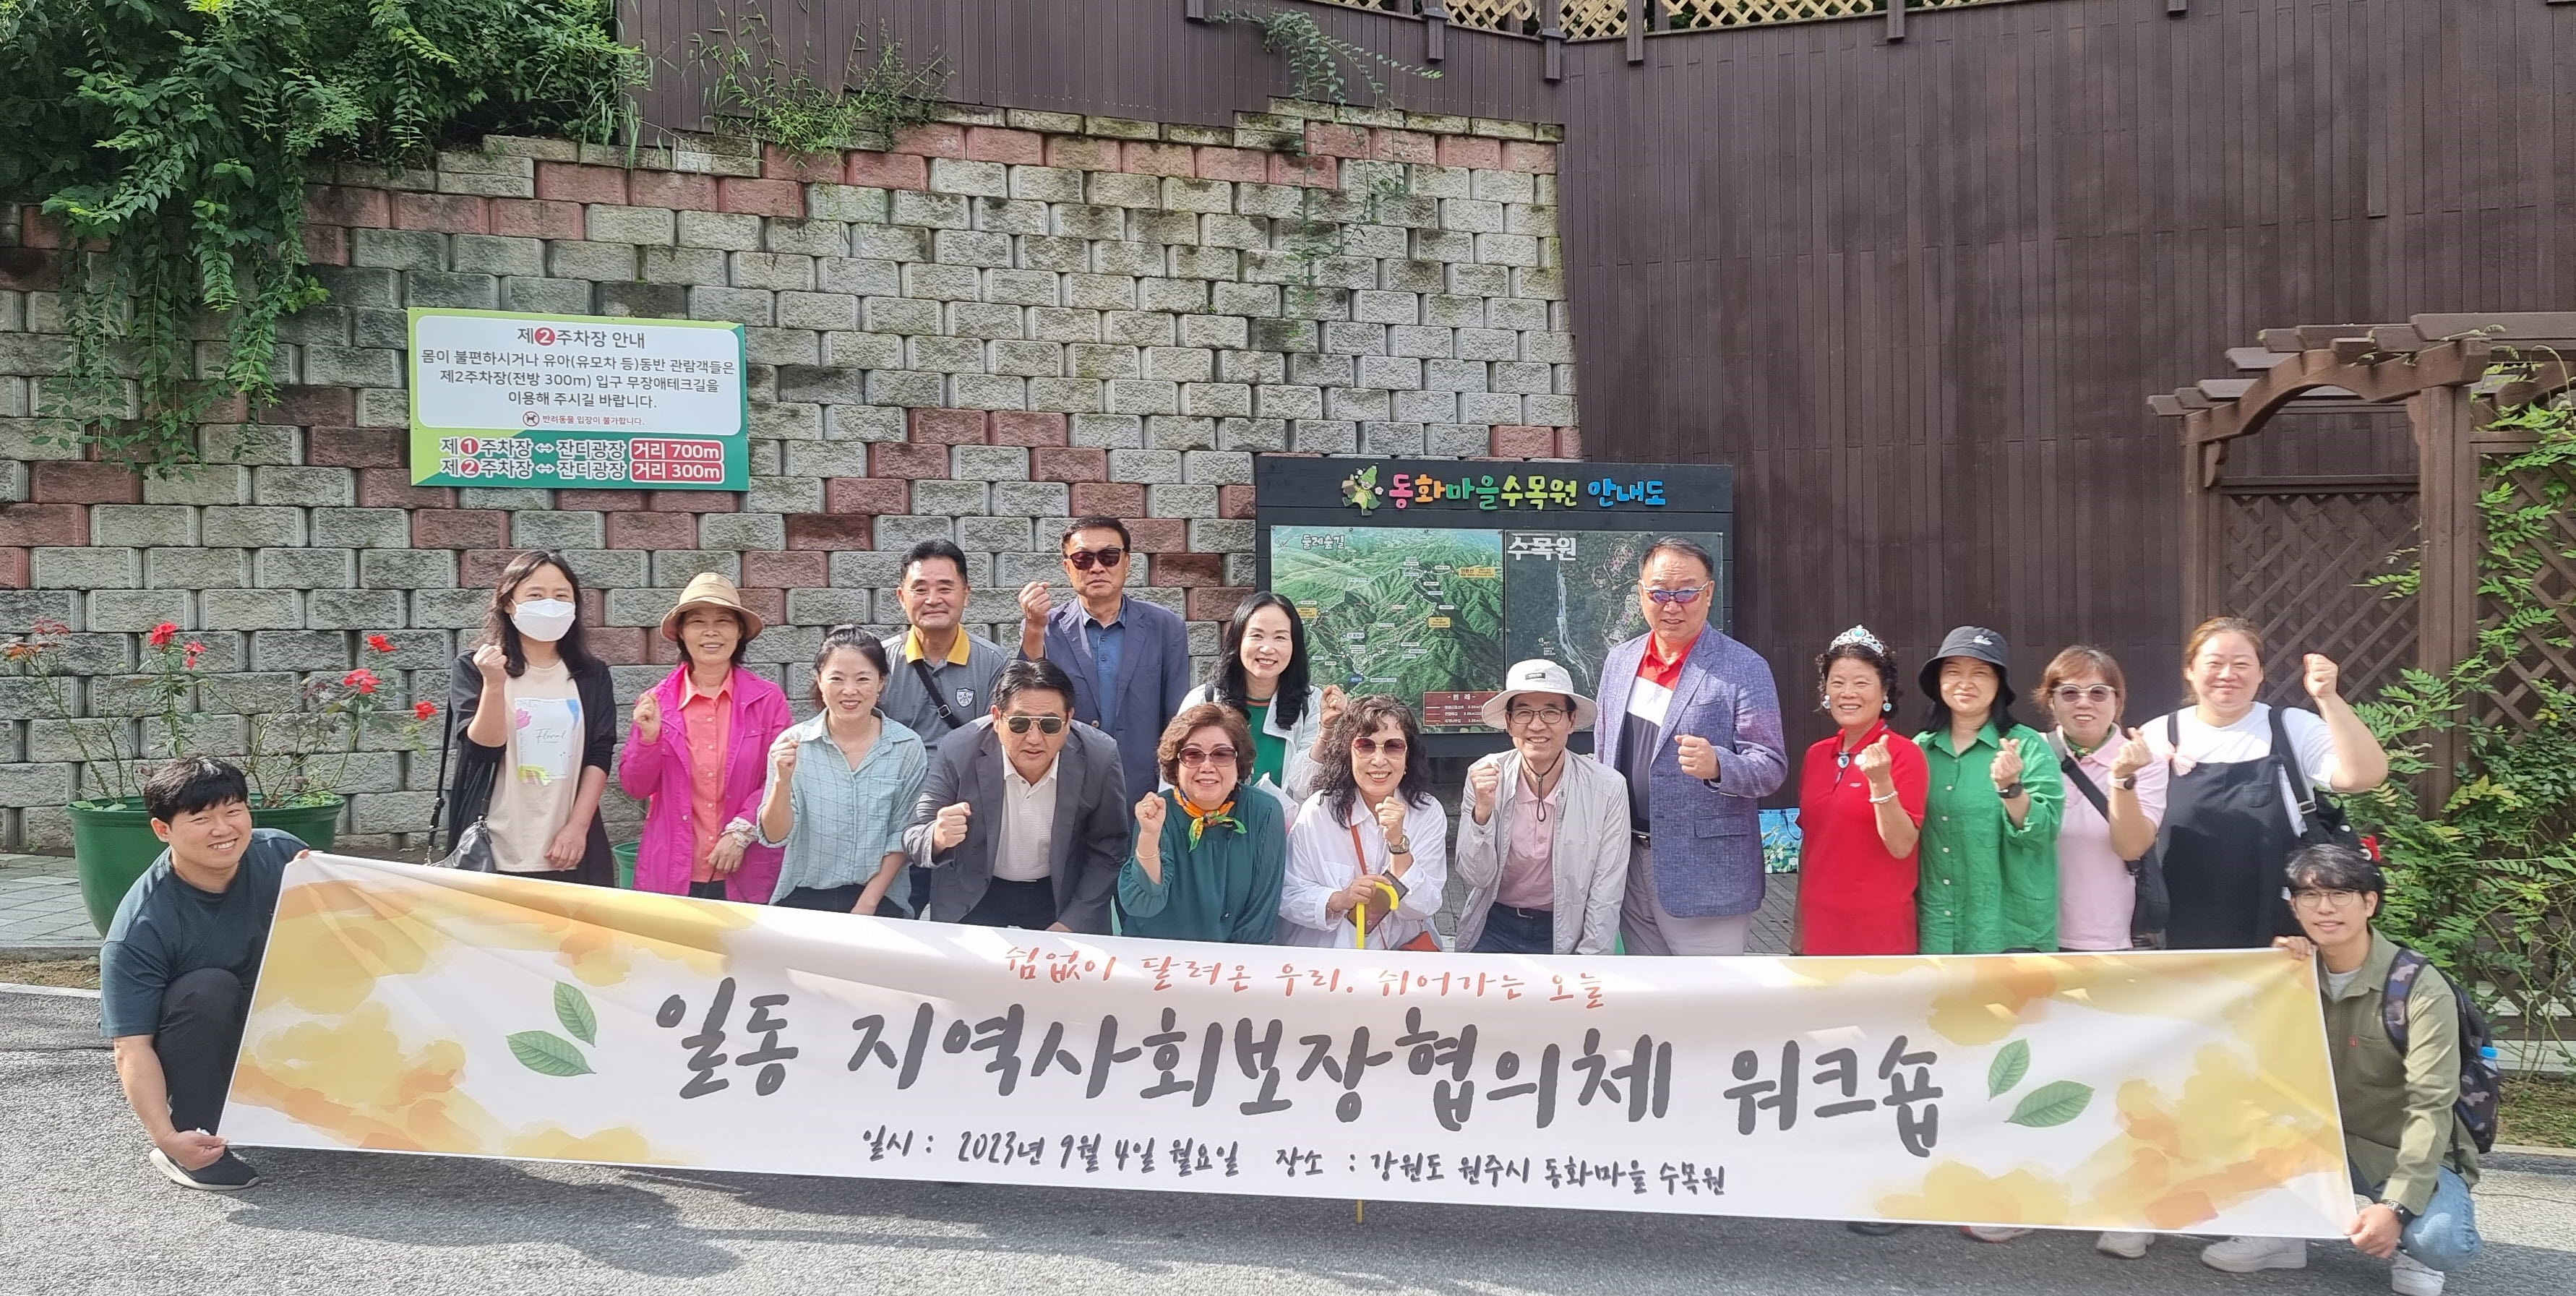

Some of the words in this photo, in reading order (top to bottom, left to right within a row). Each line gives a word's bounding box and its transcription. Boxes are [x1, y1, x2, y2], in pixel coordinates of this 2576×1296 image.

[517, 327, 607, 348] 제2주차장
[612, 332, 645, 348] 안내
[421, 349, 450, 364] 몸이
[454, 350, 539, 367] 불편하시거나
[543, 354, 617, 370] 유아(유모차
[620, 356, 666, 372] 등)동반
[669, 359, 735, 375] 관람객들은
[439, 369, 541, 387] 제2주차장(전방
[544, 374, 591, 388] 300m)
[596, 374, 623, 389] 입구
[508, 390, 549, 405] 이용해
[554, 392, 594, 408] 주시길
[599, 393, 658, 409] 바랍니다.
[577, 416, 600, 425] 입장이
[440, 437, 532, 457] 제1주차장
[557, 440, 624, 459] 잔디광장
[634, 442, 666, 459] 거리
[671, 444, 719, 459] 700m
[441, 458, 533, 478] 제2주차장
[558, 460, 625, 479] 잔디광장
[635, 462, 666, 479] 거리
[671, 464, 720, 479] 300m
[1388, 473, 1578, 511] 동화마을수목원
[1587, 477, 1666, 507] 안내도
[1301, 533, 1345, 550] 둘레숲길
[1507, 536, 1576, 561] 수목원
[1005, 947, 1117, 984] 쉼없이
[1141, 956, 1252, 993] 달려온
[1378, 969, 1524, 1001] 쉬어가는
[1549, 972, 1605, 1010] 오늘
[656, 977, 799, 1099] 일동
[847, 1002, 1673, 1132] 지역사회보장협의체
[1723, 1034, 1944, 1158] 워크숍
[862, 1124, 914, 1162] 일시
[958, 1130, 1046, 1166] 2023년
[1060, 1133, 1102, 1174] 9월
[1115, 1136, 1156, 1175] 4일
[1168, 1136, 1240, 1177] 월요일
[1275, 1146, 1324, 1178] 장소
[1370, 1149, 1445, 1183] 강원도
[1458, 1154, 1530, 1188] 원주시
[1544, 1155, 1649, 1195] 동화마을
[1659, 1159, 1726, 1197] 수목원
